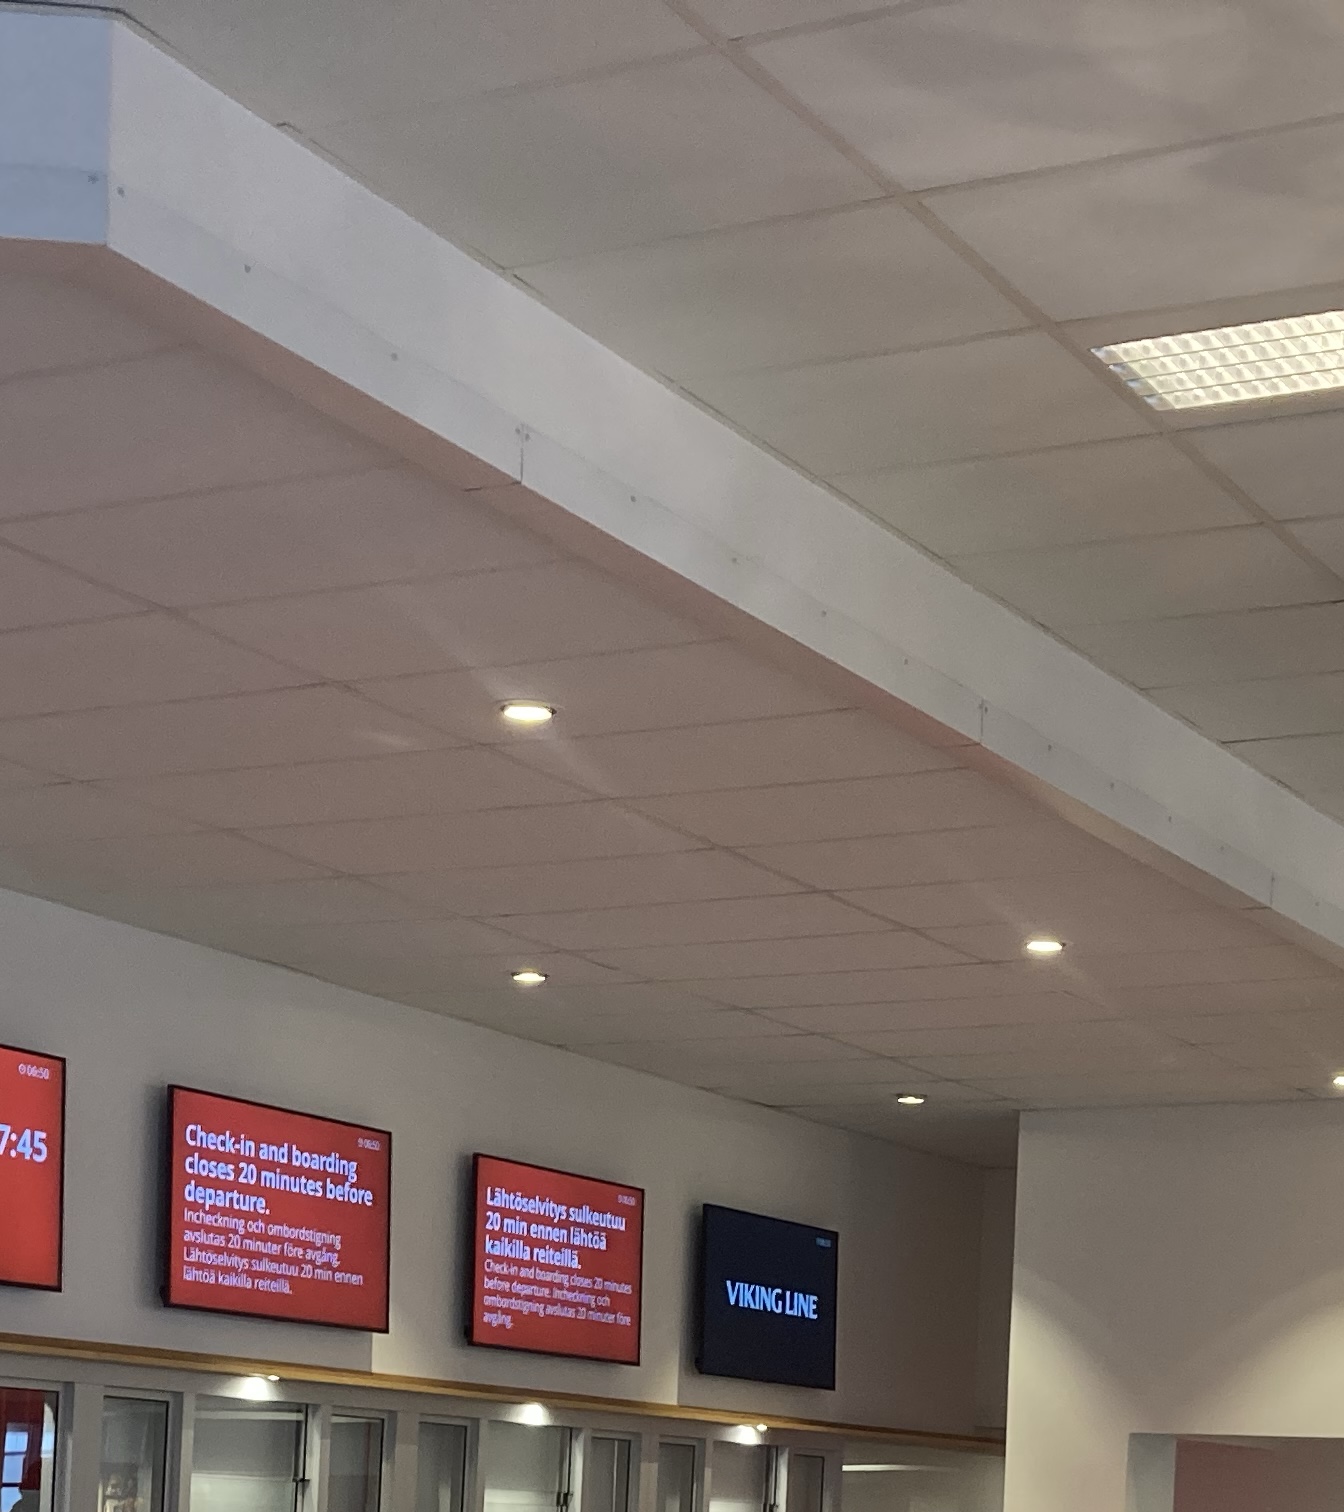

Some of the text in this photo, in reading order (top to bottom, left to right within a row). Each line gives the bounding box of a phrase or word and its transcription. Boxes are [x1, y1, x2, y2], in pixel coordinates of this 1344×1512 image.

[186, 1124, 358, 1183] Check-in and boarding
[184, 1180, 271, 1215] departure.
[185, 1152, 373, 1207] closes 20 minutes before
[184, 1207, 341, 1250] Incheckning och ombordstigning
[486, 1186, 626, 1231] Lähtöselvitys sulkeutuu
[183, 1229, 226, 1247] avslutas
[228, 1233, 241, 1249] 20
[243, 1237, 282, 1255] minuter
[284, 1242, 303, 1258] före
[485, 1211, 607, 1250] 20 min ennen lähtöä
[183, 1246, 363, 1286] Lähtöselvitys sulkeutuu 20 min ennen
[485, 1234, 582, 1269] kaikilla reiteillä.
[183, 1265, 293, 1295] lähtöä kaikilla reiteillä.
[726, 1280, 818, 1320] VIKING LINE
